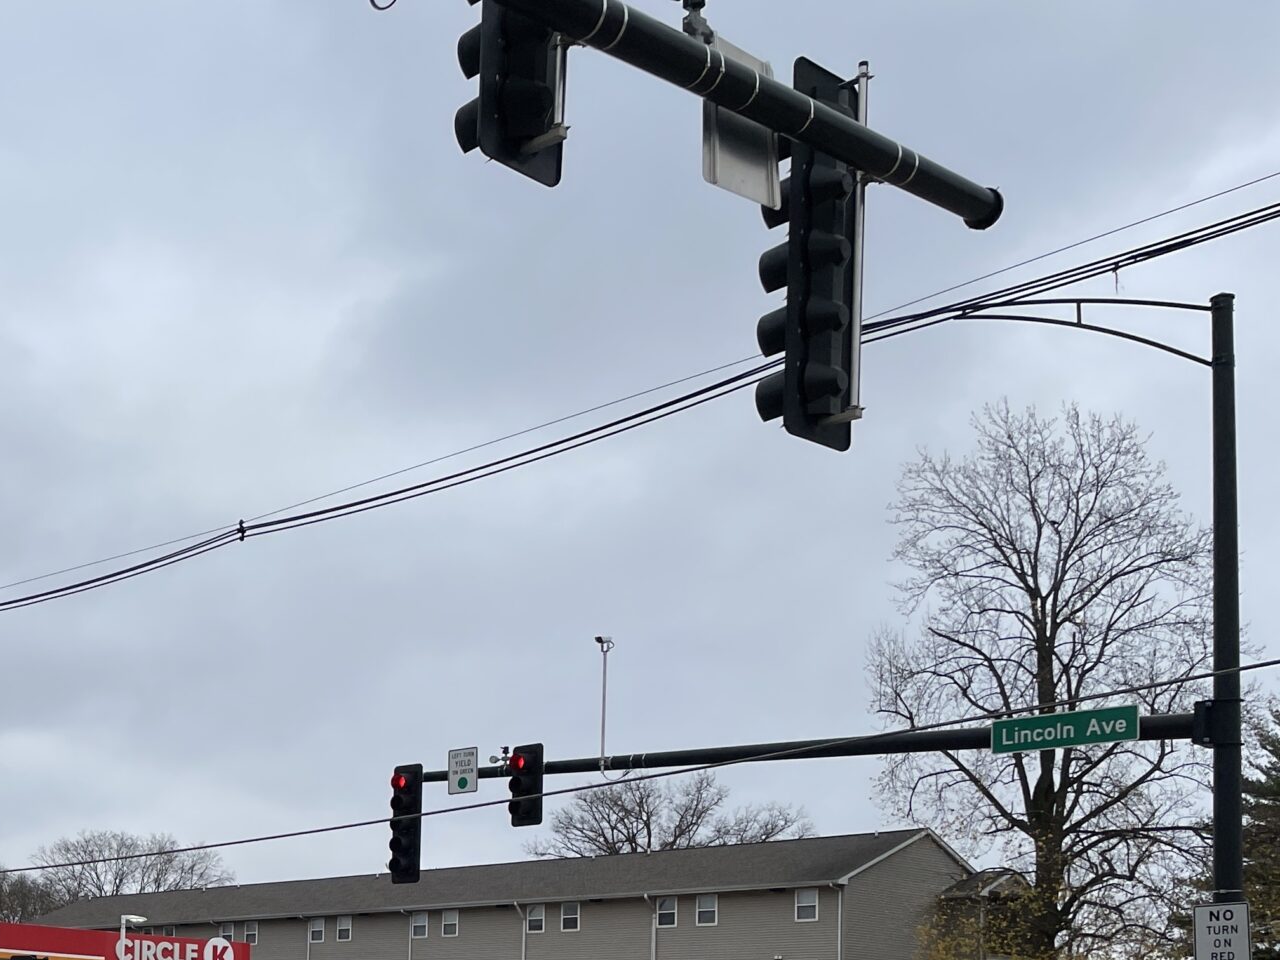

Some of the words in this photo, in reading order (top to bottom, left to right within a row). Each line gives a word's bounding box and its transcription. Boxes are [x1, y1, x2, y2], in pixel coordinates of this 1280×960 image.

[1002, 722, 1074, 745] Lincoln
[1086, 718, 1127, 736] Ave
[455, 759, 472, 767] YIELD
[1209, 909, 1234, 922] NO
[1206, 924, 1239, 936] TURN
[1213, 938, 1232, 948] ON
